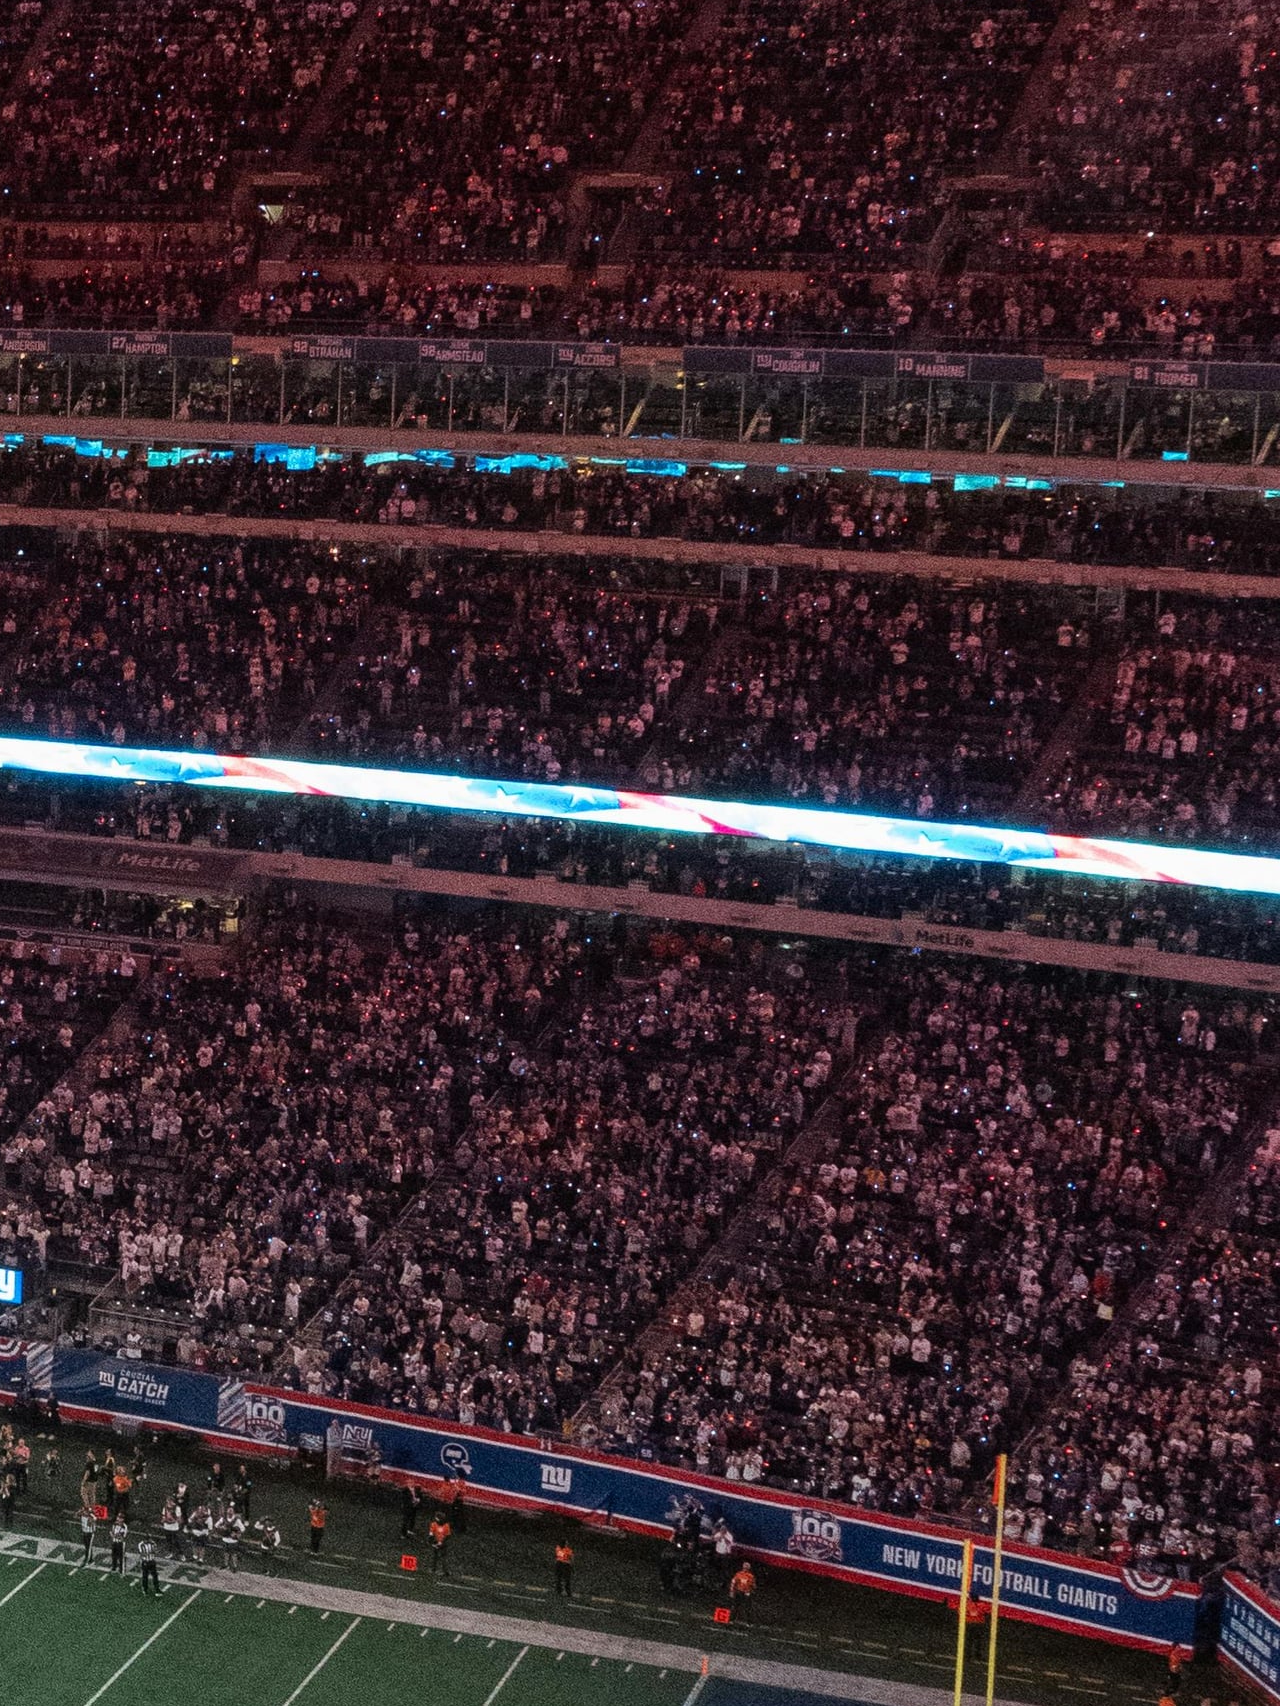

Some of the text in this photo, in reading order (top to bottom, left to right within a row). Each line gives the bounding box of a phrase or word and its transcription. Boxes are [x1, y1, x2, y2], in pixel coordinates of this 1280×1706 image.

[3, 339, 46, 352] ANDERSON
[112, 336, 168, 355] 27 HAMPTON
[293, 341, 308, 353] 92
[309, 346, 352, 359] STRAHAN
[435, 350, 484, 364] ARMSTEAD
[916, 364, 967, 378] MANNING
[118, 851, 201, 872] MetLife
[915, 929, 975, 949] MetLife
[99, 1371, 170, 1401] ny CATCH
[246, 1400, 286, 1424] 100
[541, 1463, 572, 1493] ny
[793, 1515, 841, 1543] 100
[883, 1544, 920, 1570] NEW
[926, 1554, 965, 1580] YORK
[1057, 1583, 1118, 1615] GIANTS
